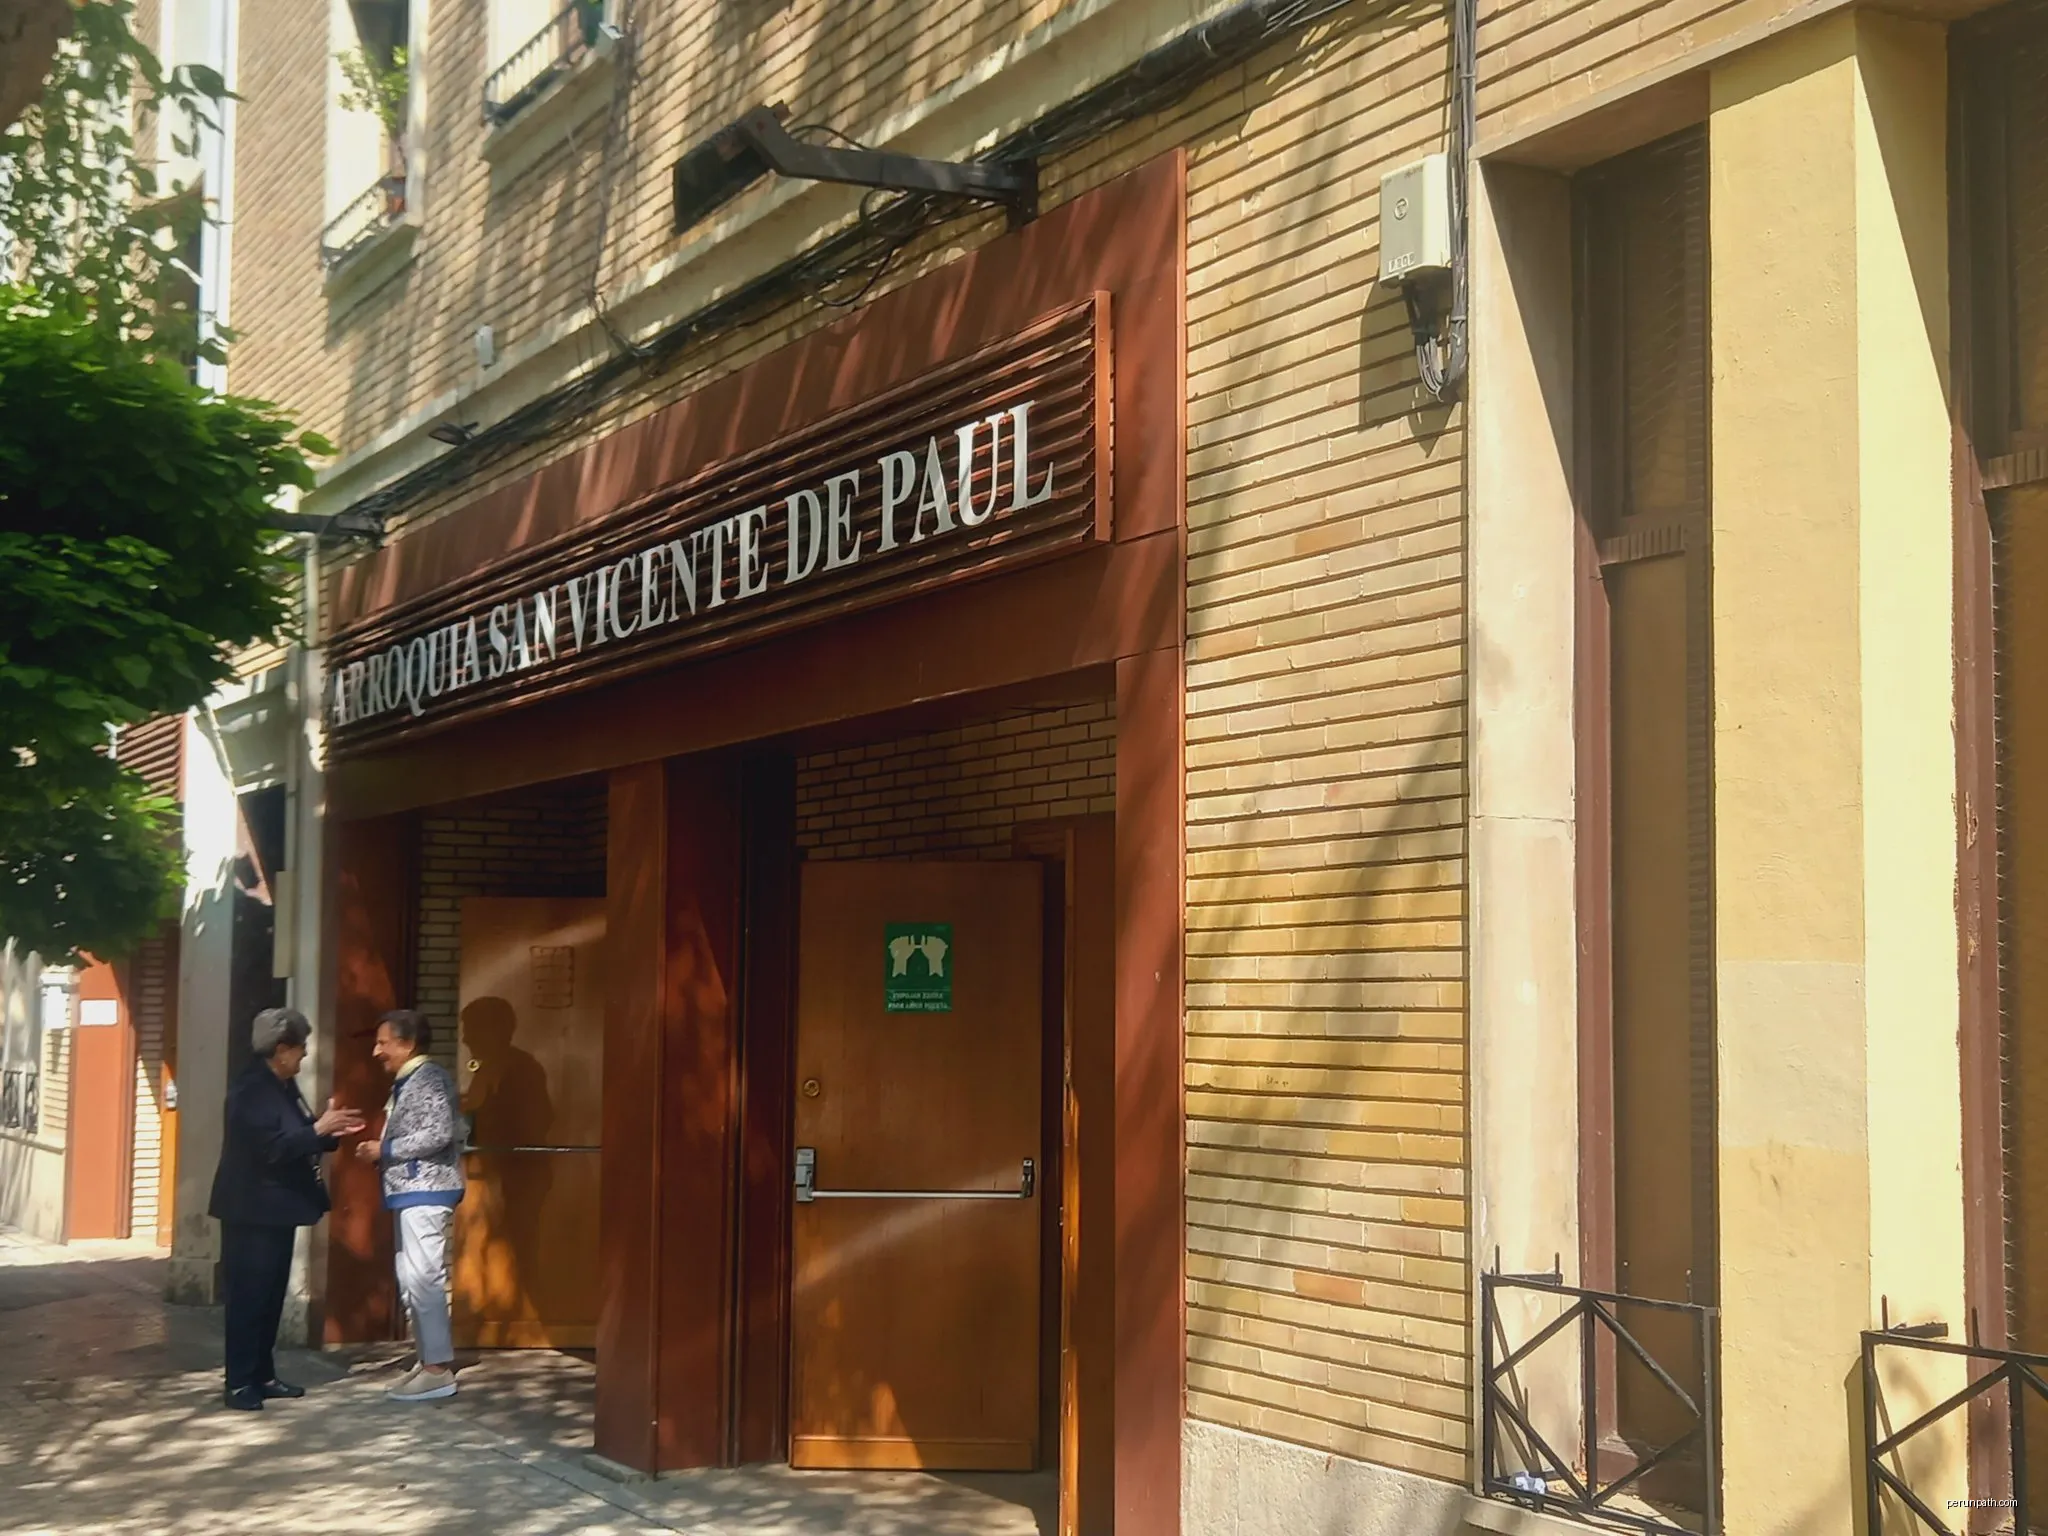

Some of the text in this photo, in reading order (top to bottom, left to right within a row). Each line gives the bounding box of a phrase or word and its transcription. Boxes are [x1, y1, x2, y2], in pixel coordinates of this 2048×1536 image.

[332, 400, 1054, 717] ARROQUIA SAN VICENTE DE PAUL
